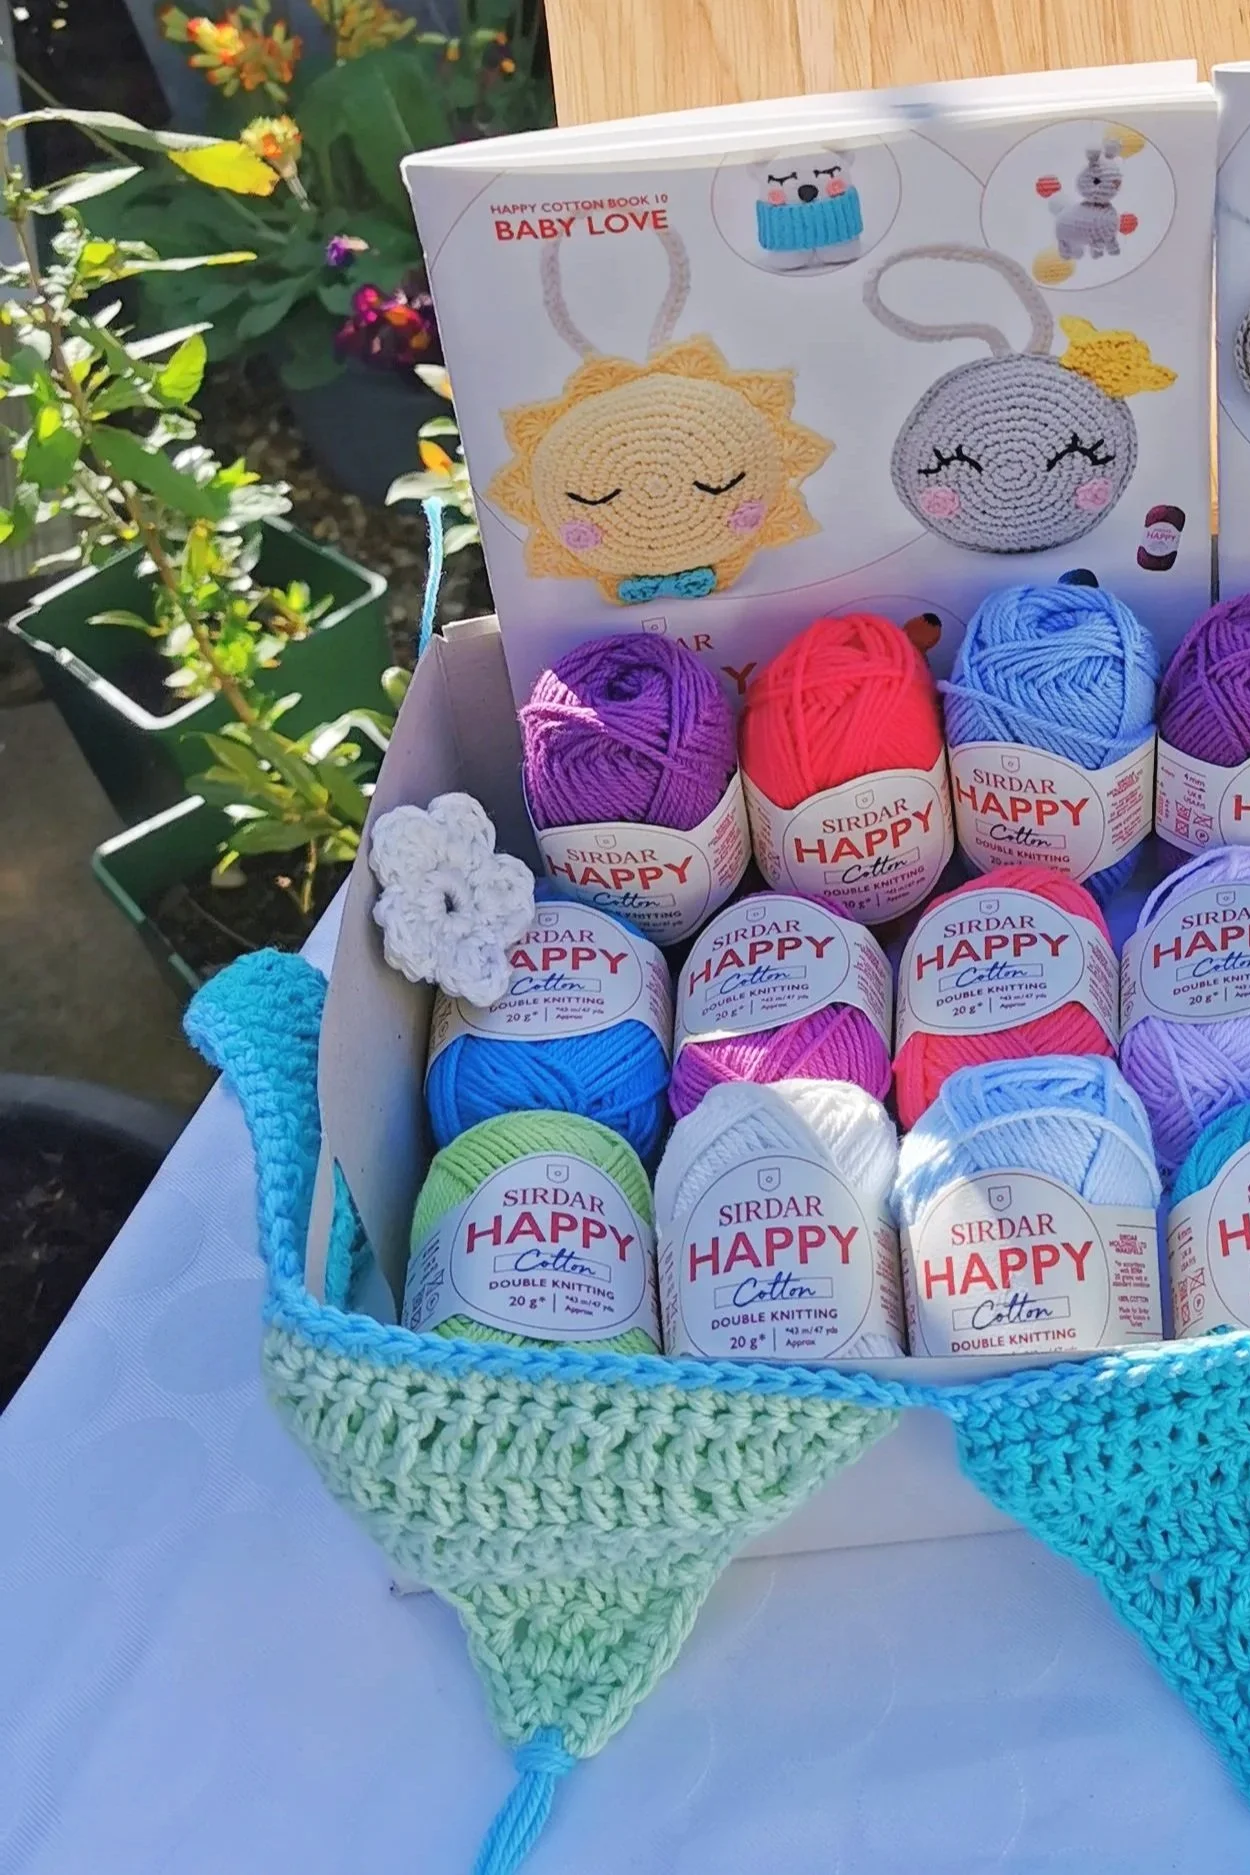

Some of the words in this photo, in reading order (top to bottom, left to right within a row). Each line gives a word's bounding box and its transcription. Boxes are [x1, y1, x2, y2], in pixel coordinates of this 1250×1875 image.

[490, 204, 536, 214] HAPPY
[541, 200, 604, 212] COTTON
[608, 195, 649, 208] BOOK
[655, 194, 668, 203] 10
[495, 217, 575, 240] BABY
[587, 210, 668, 235] LOVE
[1147, 531, 1176, 542] HAPPY
[973, 768, 1057, 795] SIRDAR
[955, 776, 1090, 826] HAPPY
[822, 798, 908, 833] SIRDAR
[794, 799, 933, 864] HAPPY
[990, 824, 1052, 847] Cotton
[566, 849, 658, 864] SIRDAR
[976, 837, 1014, 856] DOUBLE
[1017, 851, 1070, 863] KNITTING
[546, 854, 693, 890] HAPPY
[824, 885, 870, 896] DOUBLE
[874, 866, 925, 890] KNITTING
[842, 855, 908, 884] Cotton
[592, 892, 660, 908] Cotton
[712, 919, 802, 951] SIRDAR
[944, 915, 1036, 938] SIRDAR
[509, 947, 629, 975] APPY
[689, 936, 835, 997] HAPPY
[916, 932, 1070, 981] HAPPY
[510, 973, 586, 996] Cotton
[719, 965, 790, 995] Cotton
[955, 961, 1028, 989] Cotton
[1173, 978, 1220, 996] DOUBLE
[489, 998, 539, 1013] DOUBLE
[543, 997, 604, 1005] KNITTING
[702, 992, 745, 1016] DOUBLE
[750, 984, 809, 997] KNITTING
[936, 989, 983, 1007] DOUBLE
[987, 982, 1047, 995] KNITTING
[1188, 995, 1203, 1006] 20
[506, 1013, 521, 1023] 20
[715, 1010, 729, 1021] 20
[952, 1005, 966, 1016] 20
[502, 1187, 605, 1216] SIRDAR
[718, 1195, 824, 1227] SIRDAR
[466, 1211, 635, 1262] HAPPY
[951, 1213, 1057, 1247] SIRDAR
[514, 1248, 597, 1275] Cotton
[689, 1224, 859, 1283] HAPPY
[922, 1240, 1093, 1300] HAPPY
[489, 1278, 547, 1291] DOUBLE
[551, 1279, 615, 1300] KNITTING
[509, 1295, 526, 1307] 20
[733, 1271, 816, 1307] Cotton
[711, 1314, 766, 1330] DOUBLE
[770, 1308, 839, 1322] KNITTING
[971, 1292, 1053, 1330] Cotton
[730, 1336, 746, 1350] 20
[951, 1336, 1005, 1353] DOUBLE
[1009, 1328, 1077, 1345] KNITTING
